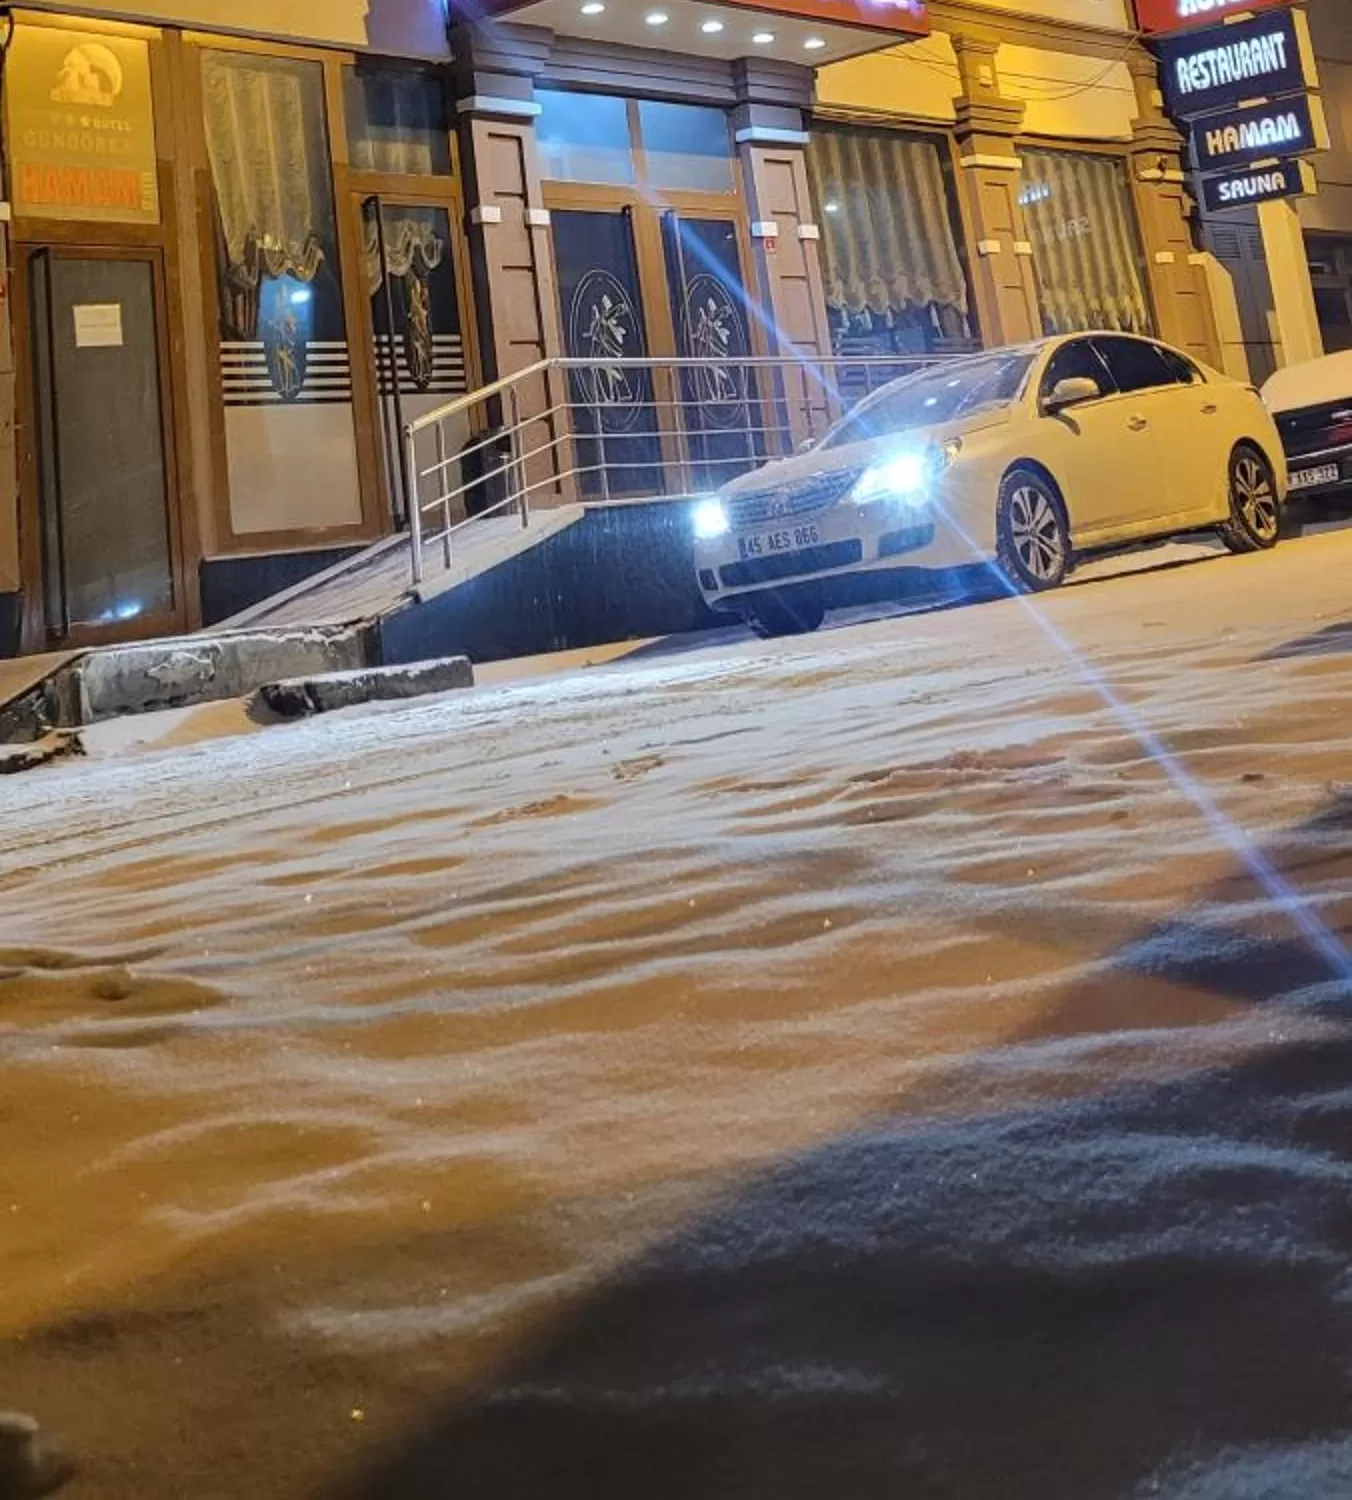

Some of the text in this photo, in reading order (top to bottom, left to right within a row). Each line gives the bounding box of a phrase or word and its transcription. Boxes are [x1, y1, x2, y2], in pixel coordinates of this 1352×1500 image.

[1176, 31, 1288, 95] RESTAURANT
[1205, 111, 1301, 156] HAMAM
[1219, 170, 1287, 201] SAUNA
